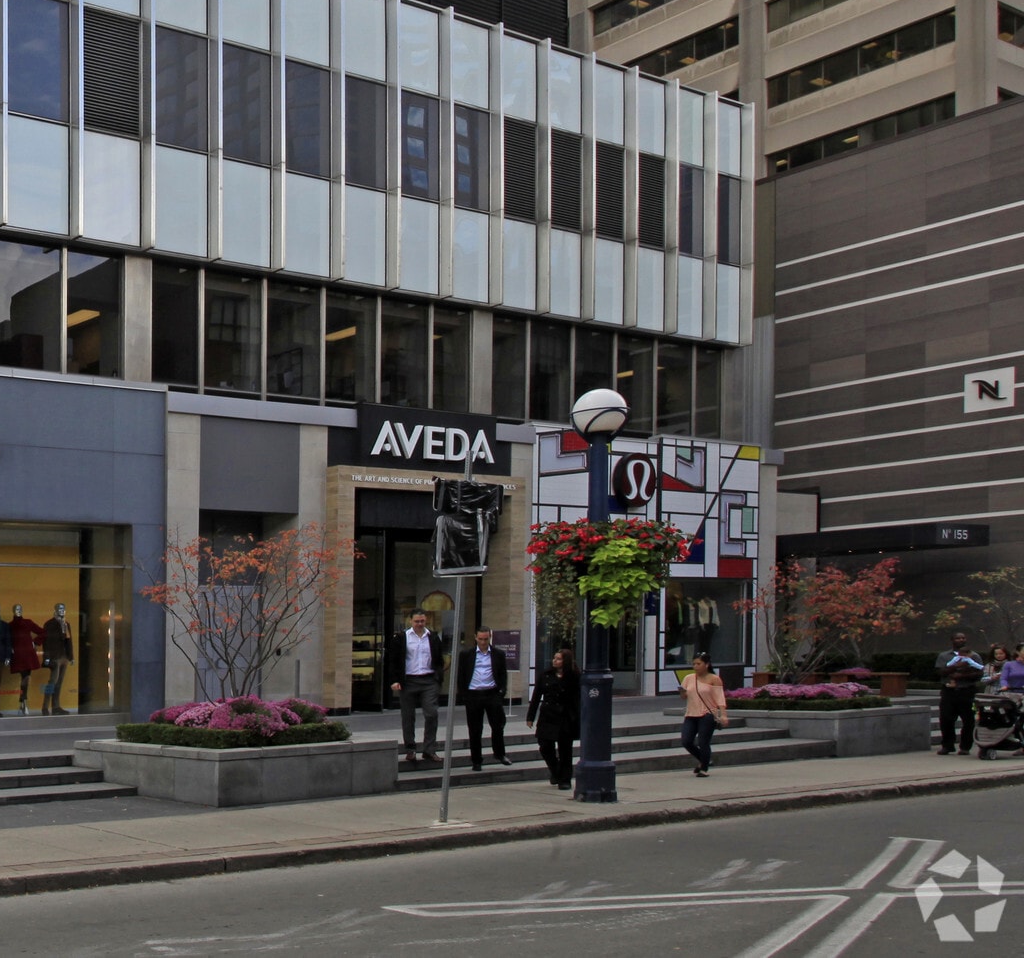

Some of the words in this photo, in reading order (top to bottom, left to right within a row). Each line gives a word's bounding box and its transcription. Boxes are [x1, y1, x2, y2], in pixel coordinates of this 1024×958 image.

[370, 420, 495, 464] AVEDA
[351, 474, 362, 482] THE
[953, 529, 968, 540] 155
